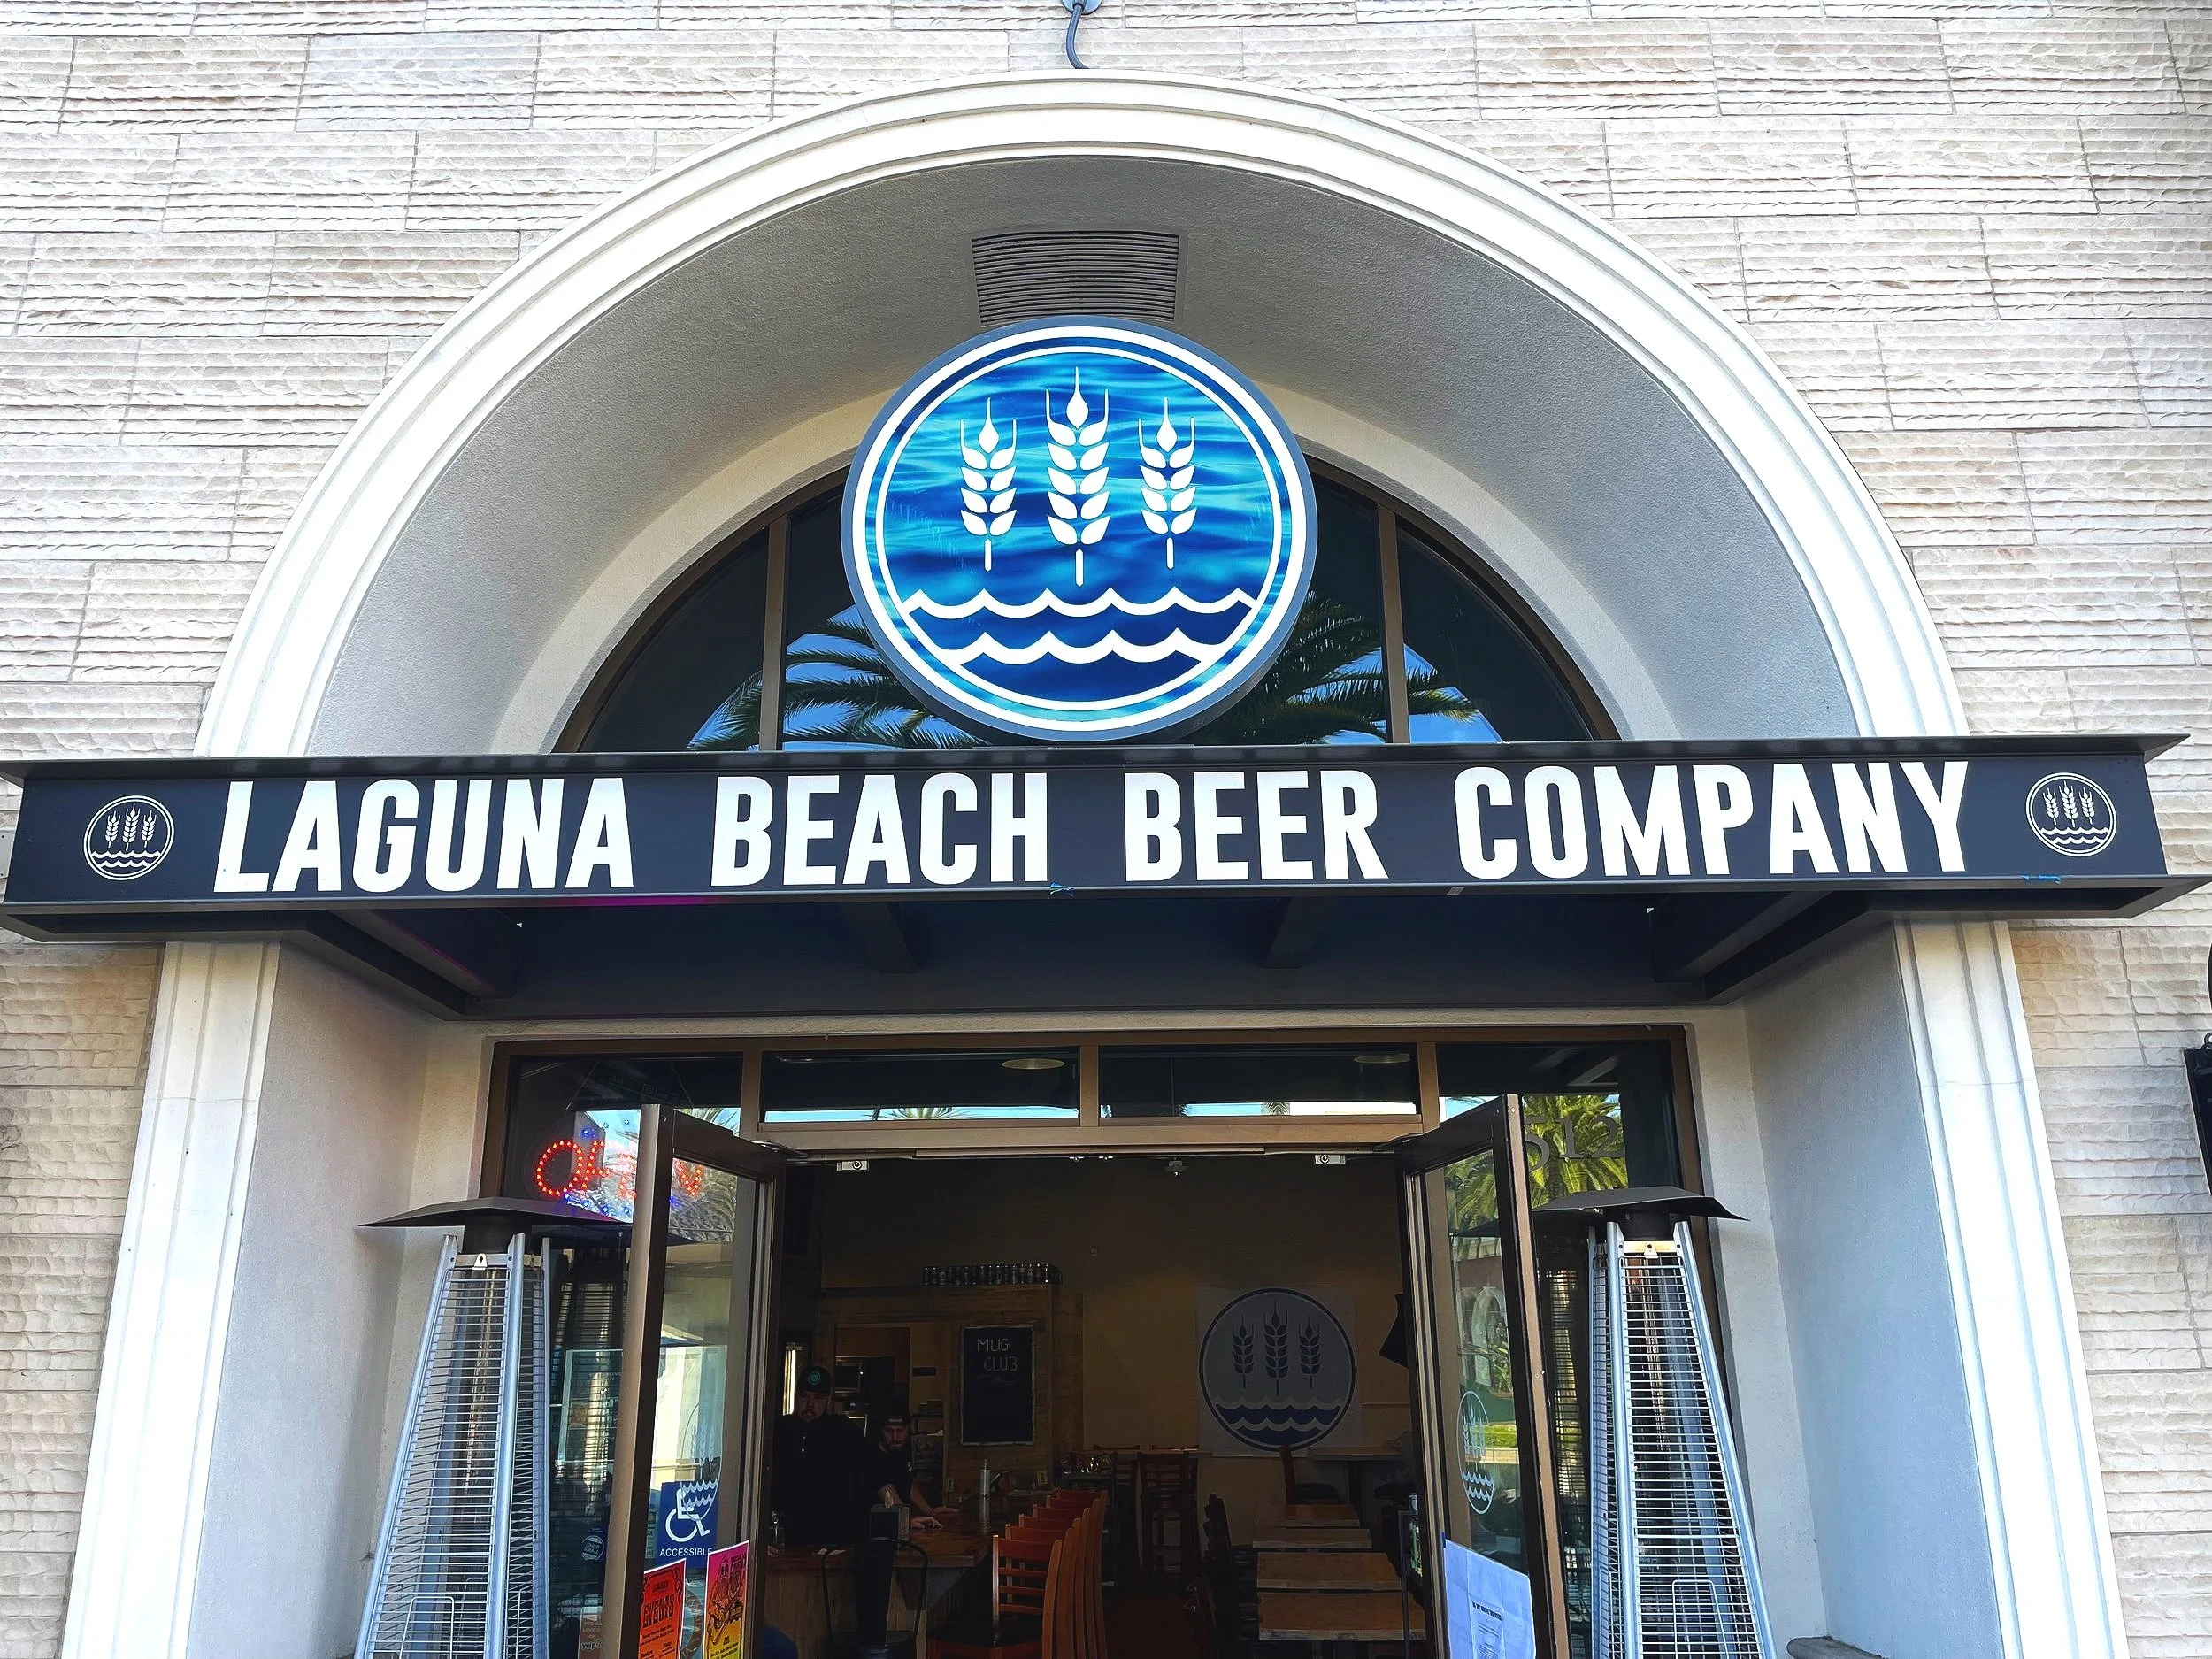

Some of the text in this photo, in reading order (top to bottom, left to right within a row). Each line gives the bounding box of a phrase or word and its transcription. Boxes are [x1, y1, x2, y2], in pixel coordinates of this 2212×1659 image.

[215, 762, 1966, 893] LAGUNA BEACH BEER COMPANY
[977, 1338, 1010, 1353] MUG
[983, 1356, 1018, 1371] CLUB
[659, 1548, 713, 1557] ACCESSIBLE
[642, 1594, 675, 1629] EVENTS
